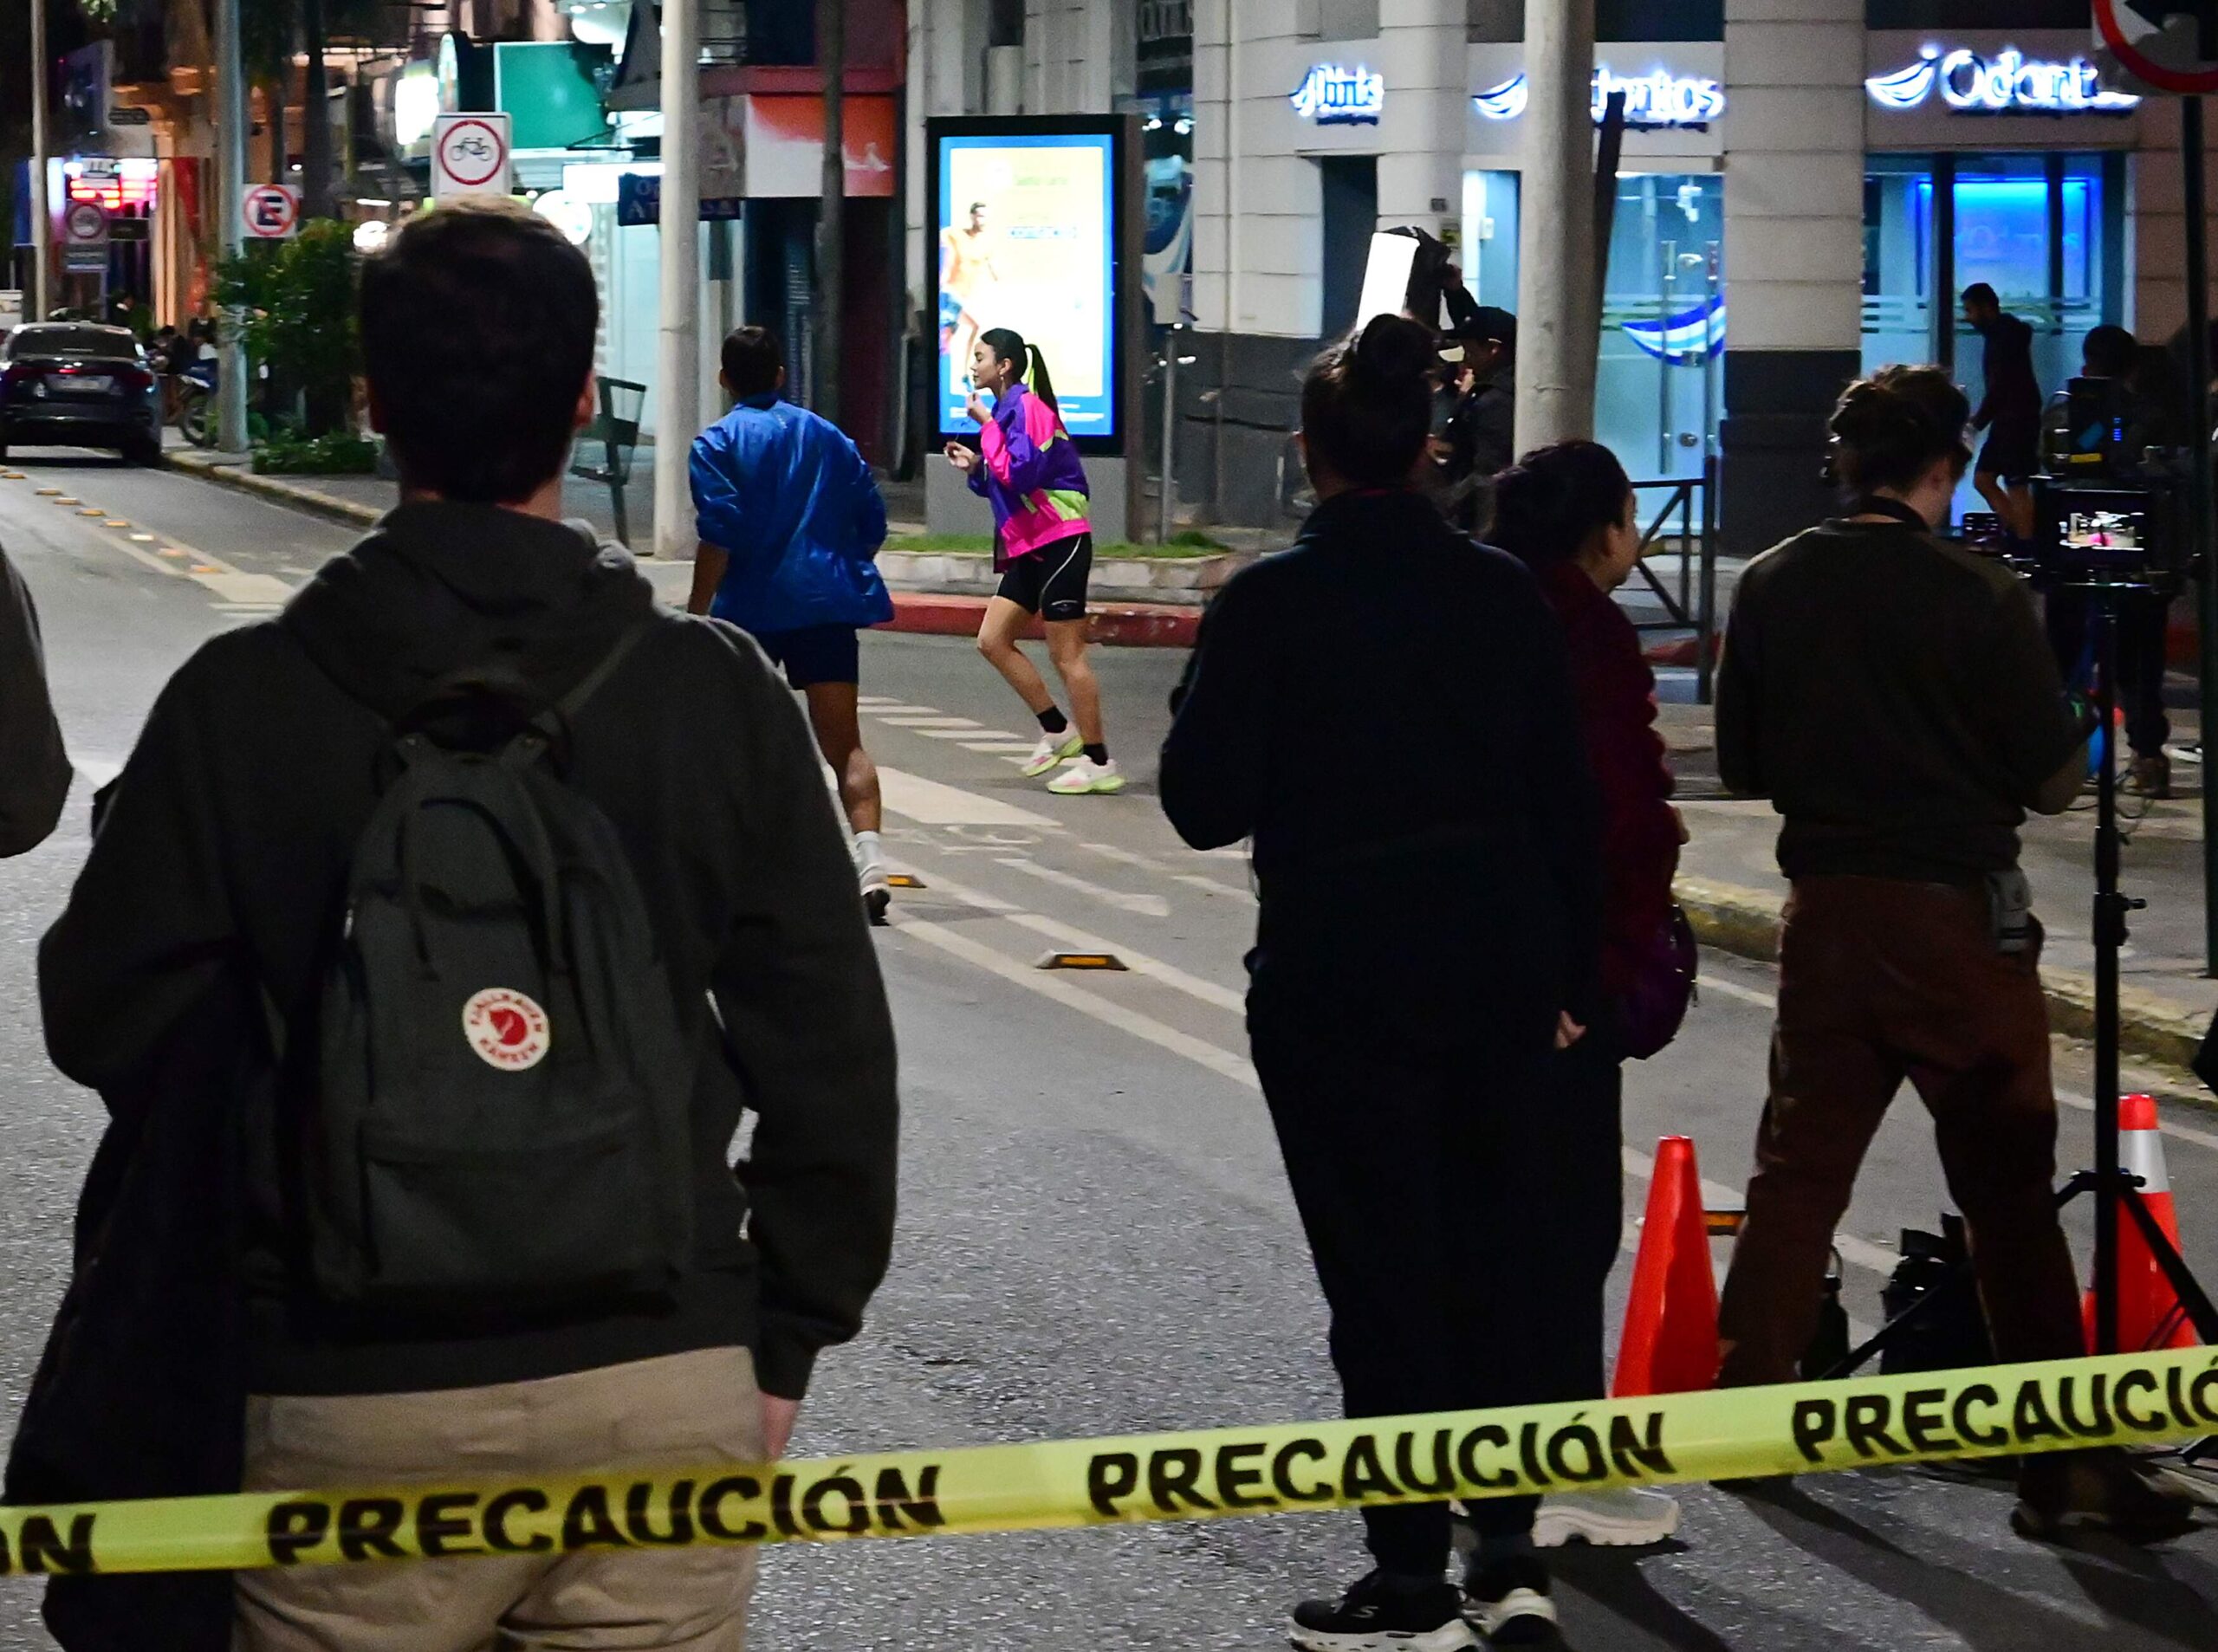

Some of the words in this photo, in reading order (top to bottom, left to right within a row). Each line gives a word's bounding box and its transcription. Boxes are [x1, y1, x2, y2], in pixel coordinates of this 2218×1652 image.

[0, 1513, 96, 1575] N
[266, 1463, 945, 1565] PRECAUCIÓN
[1087, 1410, 1678, 1517] PRECAUCIÓN
